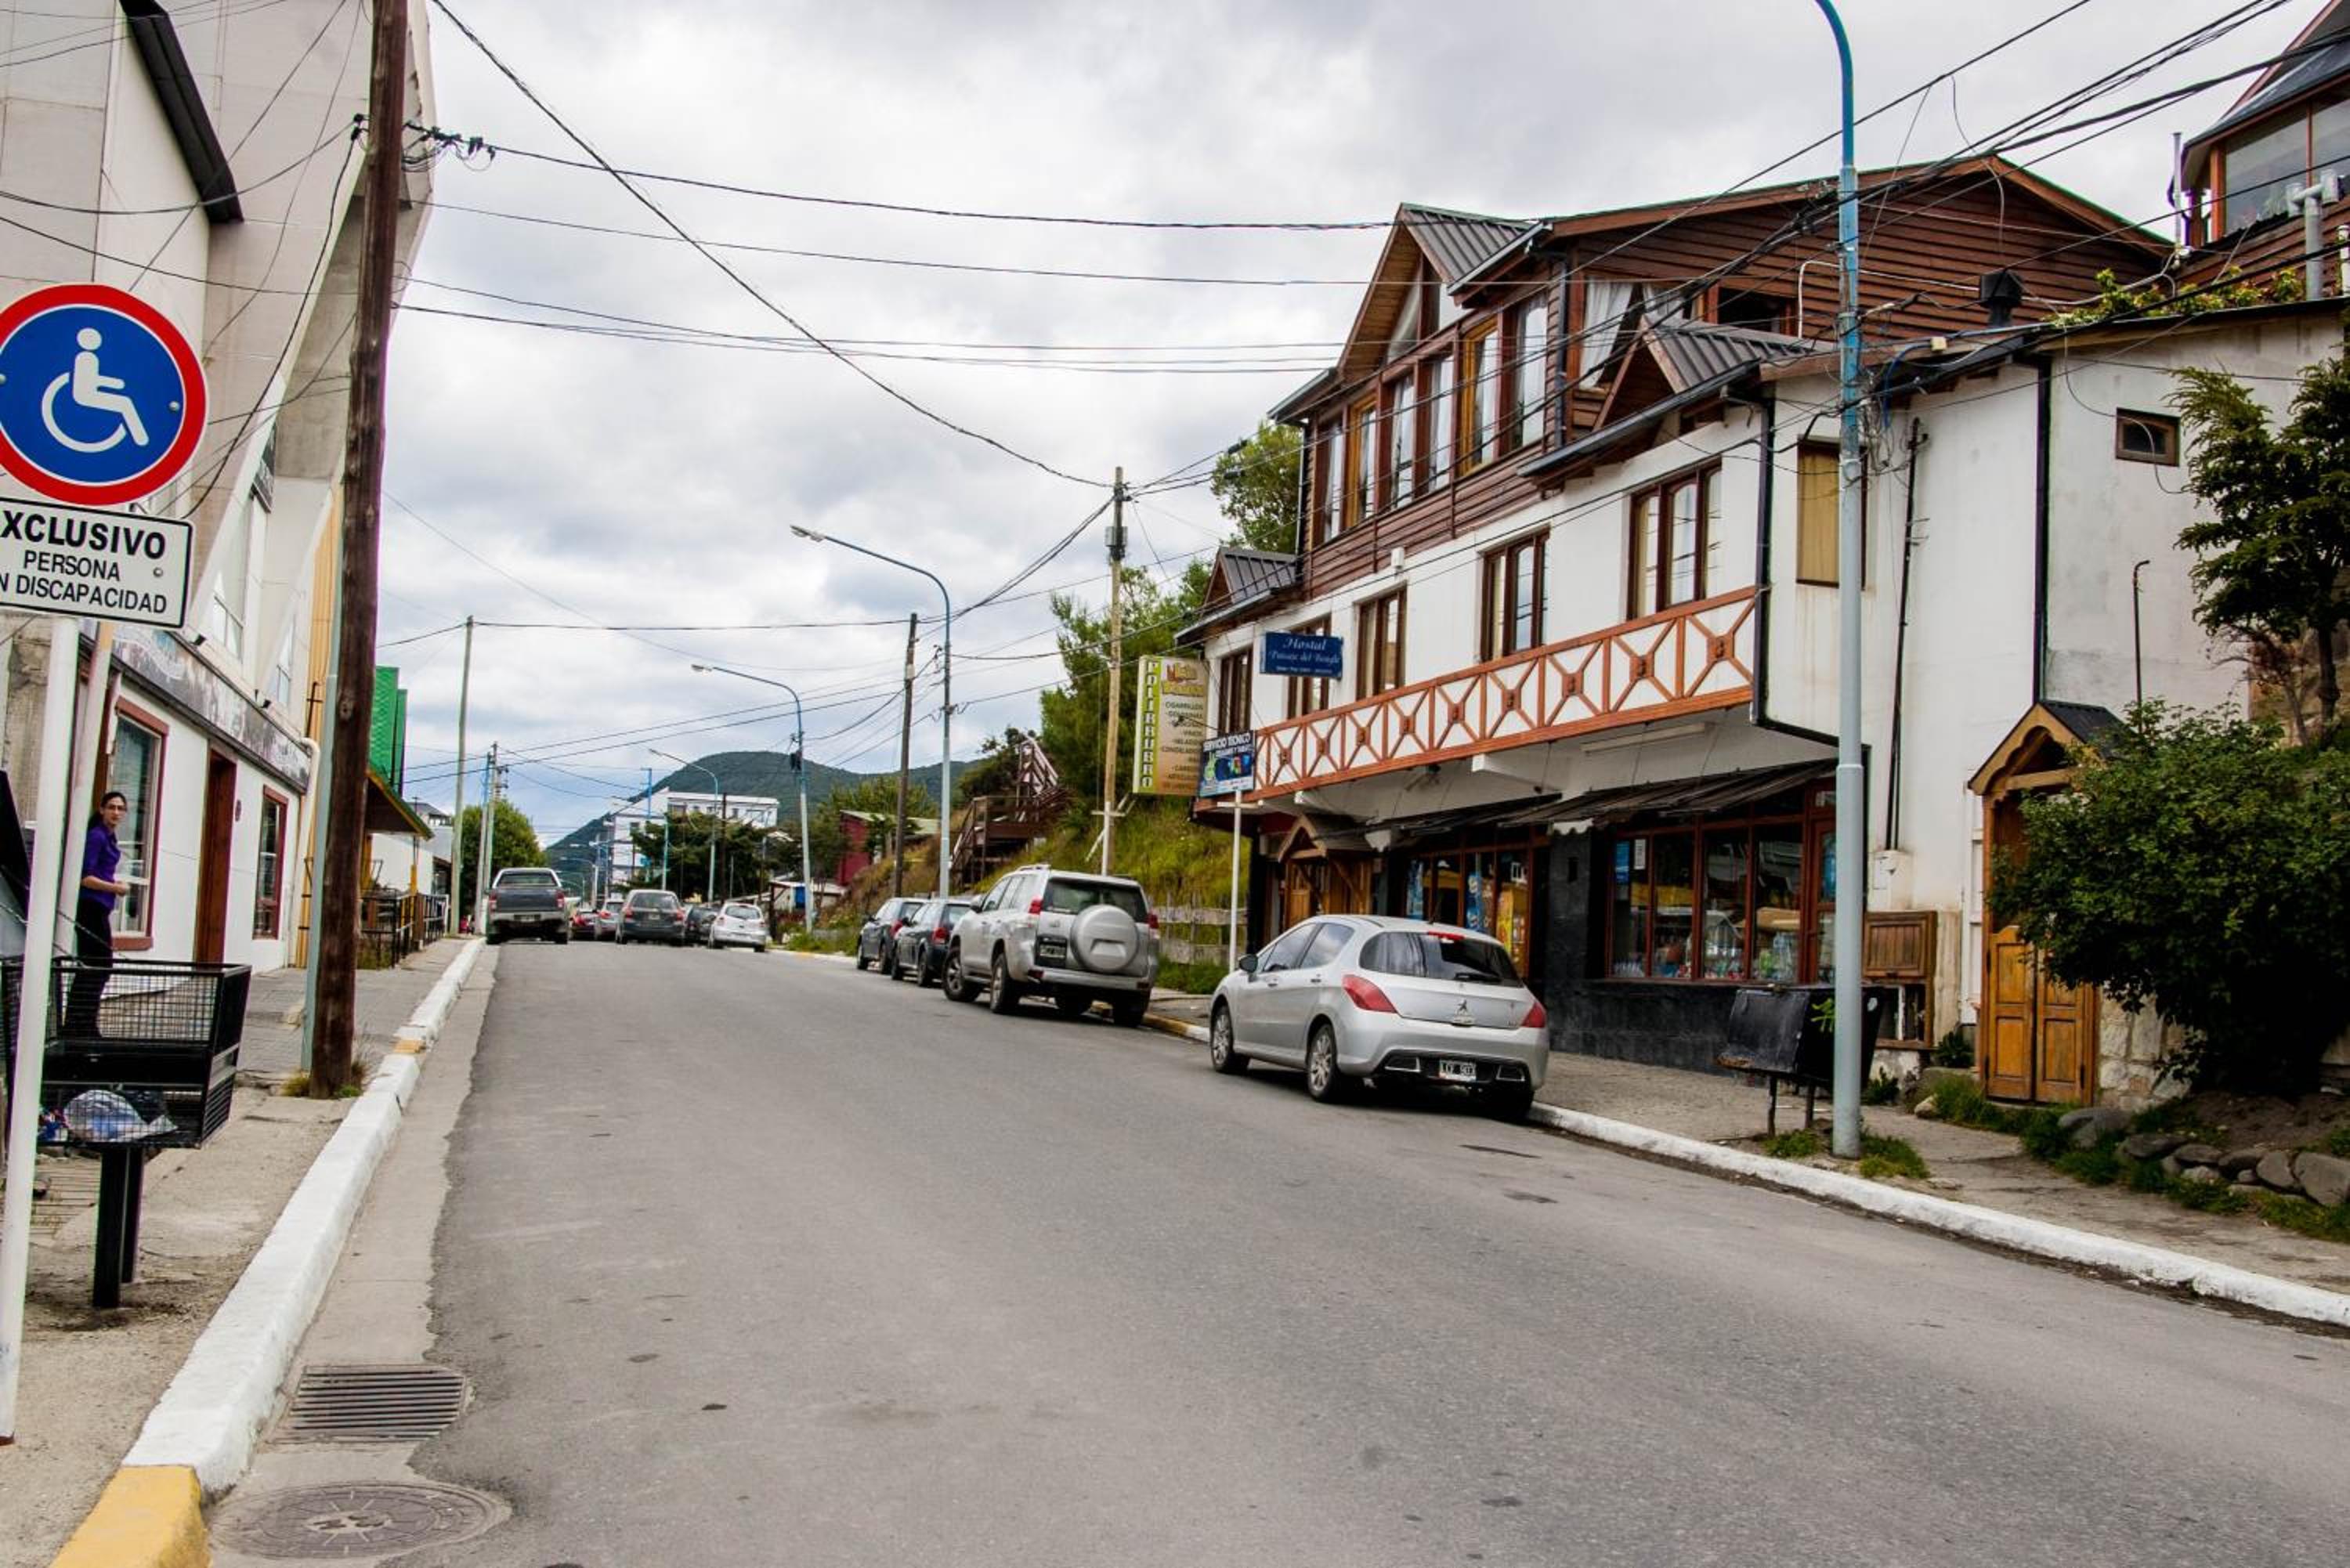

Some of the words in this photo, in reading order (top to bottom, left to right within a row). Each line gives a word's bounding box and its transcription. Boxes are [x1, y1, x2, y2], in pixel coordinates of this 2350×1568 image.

[24, 549, 121, 582] PERSONA
[16, 574, 168, 614] DISCAPACIDAD
[1282, 638, 1328, 651] Hostal
